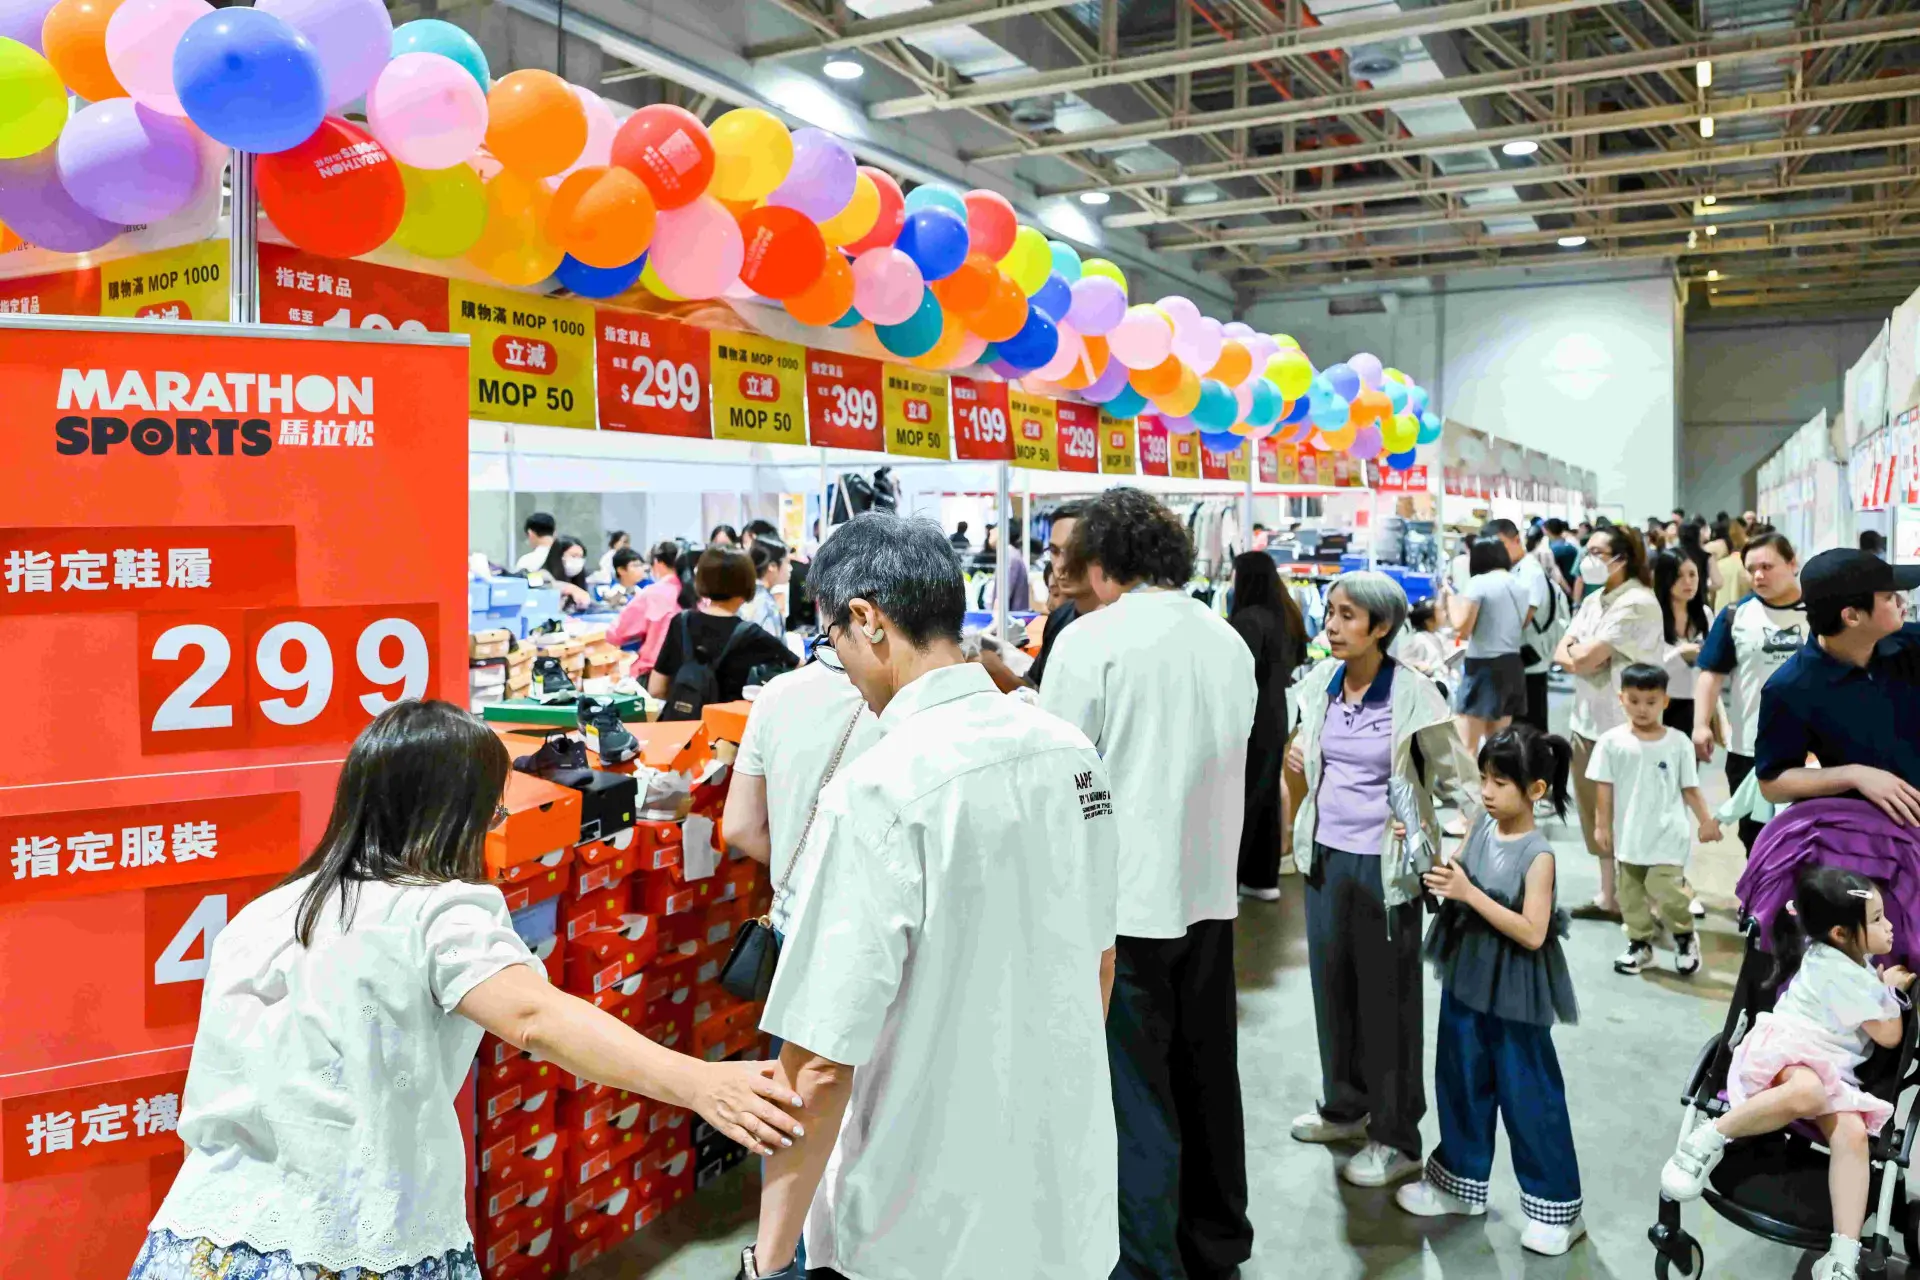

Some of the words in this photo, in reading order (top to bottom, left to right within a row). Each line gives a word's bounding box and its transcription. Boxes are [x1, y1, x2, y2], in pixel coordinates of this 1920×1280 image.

[108, 277, 144, 300] 購物滿
[149, 271, 178, 292] MOP
[184, 264, 220, 286] 1000
[276, 266, 352, 298] 指定貨品
[289, 308, 314, 324] 低至
[461, 300, 507, 324] 購物滿
[512, 311, 546, 329] MOP
[552, 319, 585, 336] 1000
[604, 325, 650, 348] 指定貨品
[505, 340, 546, 369] 立減
[751, 352, 773, 366] MOP
[777, 356, 799, 370] 1000
[56, 368, 374, 415] MARATHON
[478, 378, 537, 407] MOP
[547, 387, 574, 412] 50
[620, 355, 700, 412] $299
[55, 416, 272, 457] SPORTS
[278, 419, 374, 448] 馬拉松
[730, 407, 768, 430] MOP
[774, 413, 791, 432] 50
[896, 428, 924, 446] MOP
[928, 432, 941, 449] 50
[4, 547, 213, 594] 指定鞋履
[150, 617, 430, 733] 299
[1074, 771, 1093, 790] AAPE
[10, 820, 218, 881] 指定服裝
[25, 1092, 180, 1157] 指定襪
